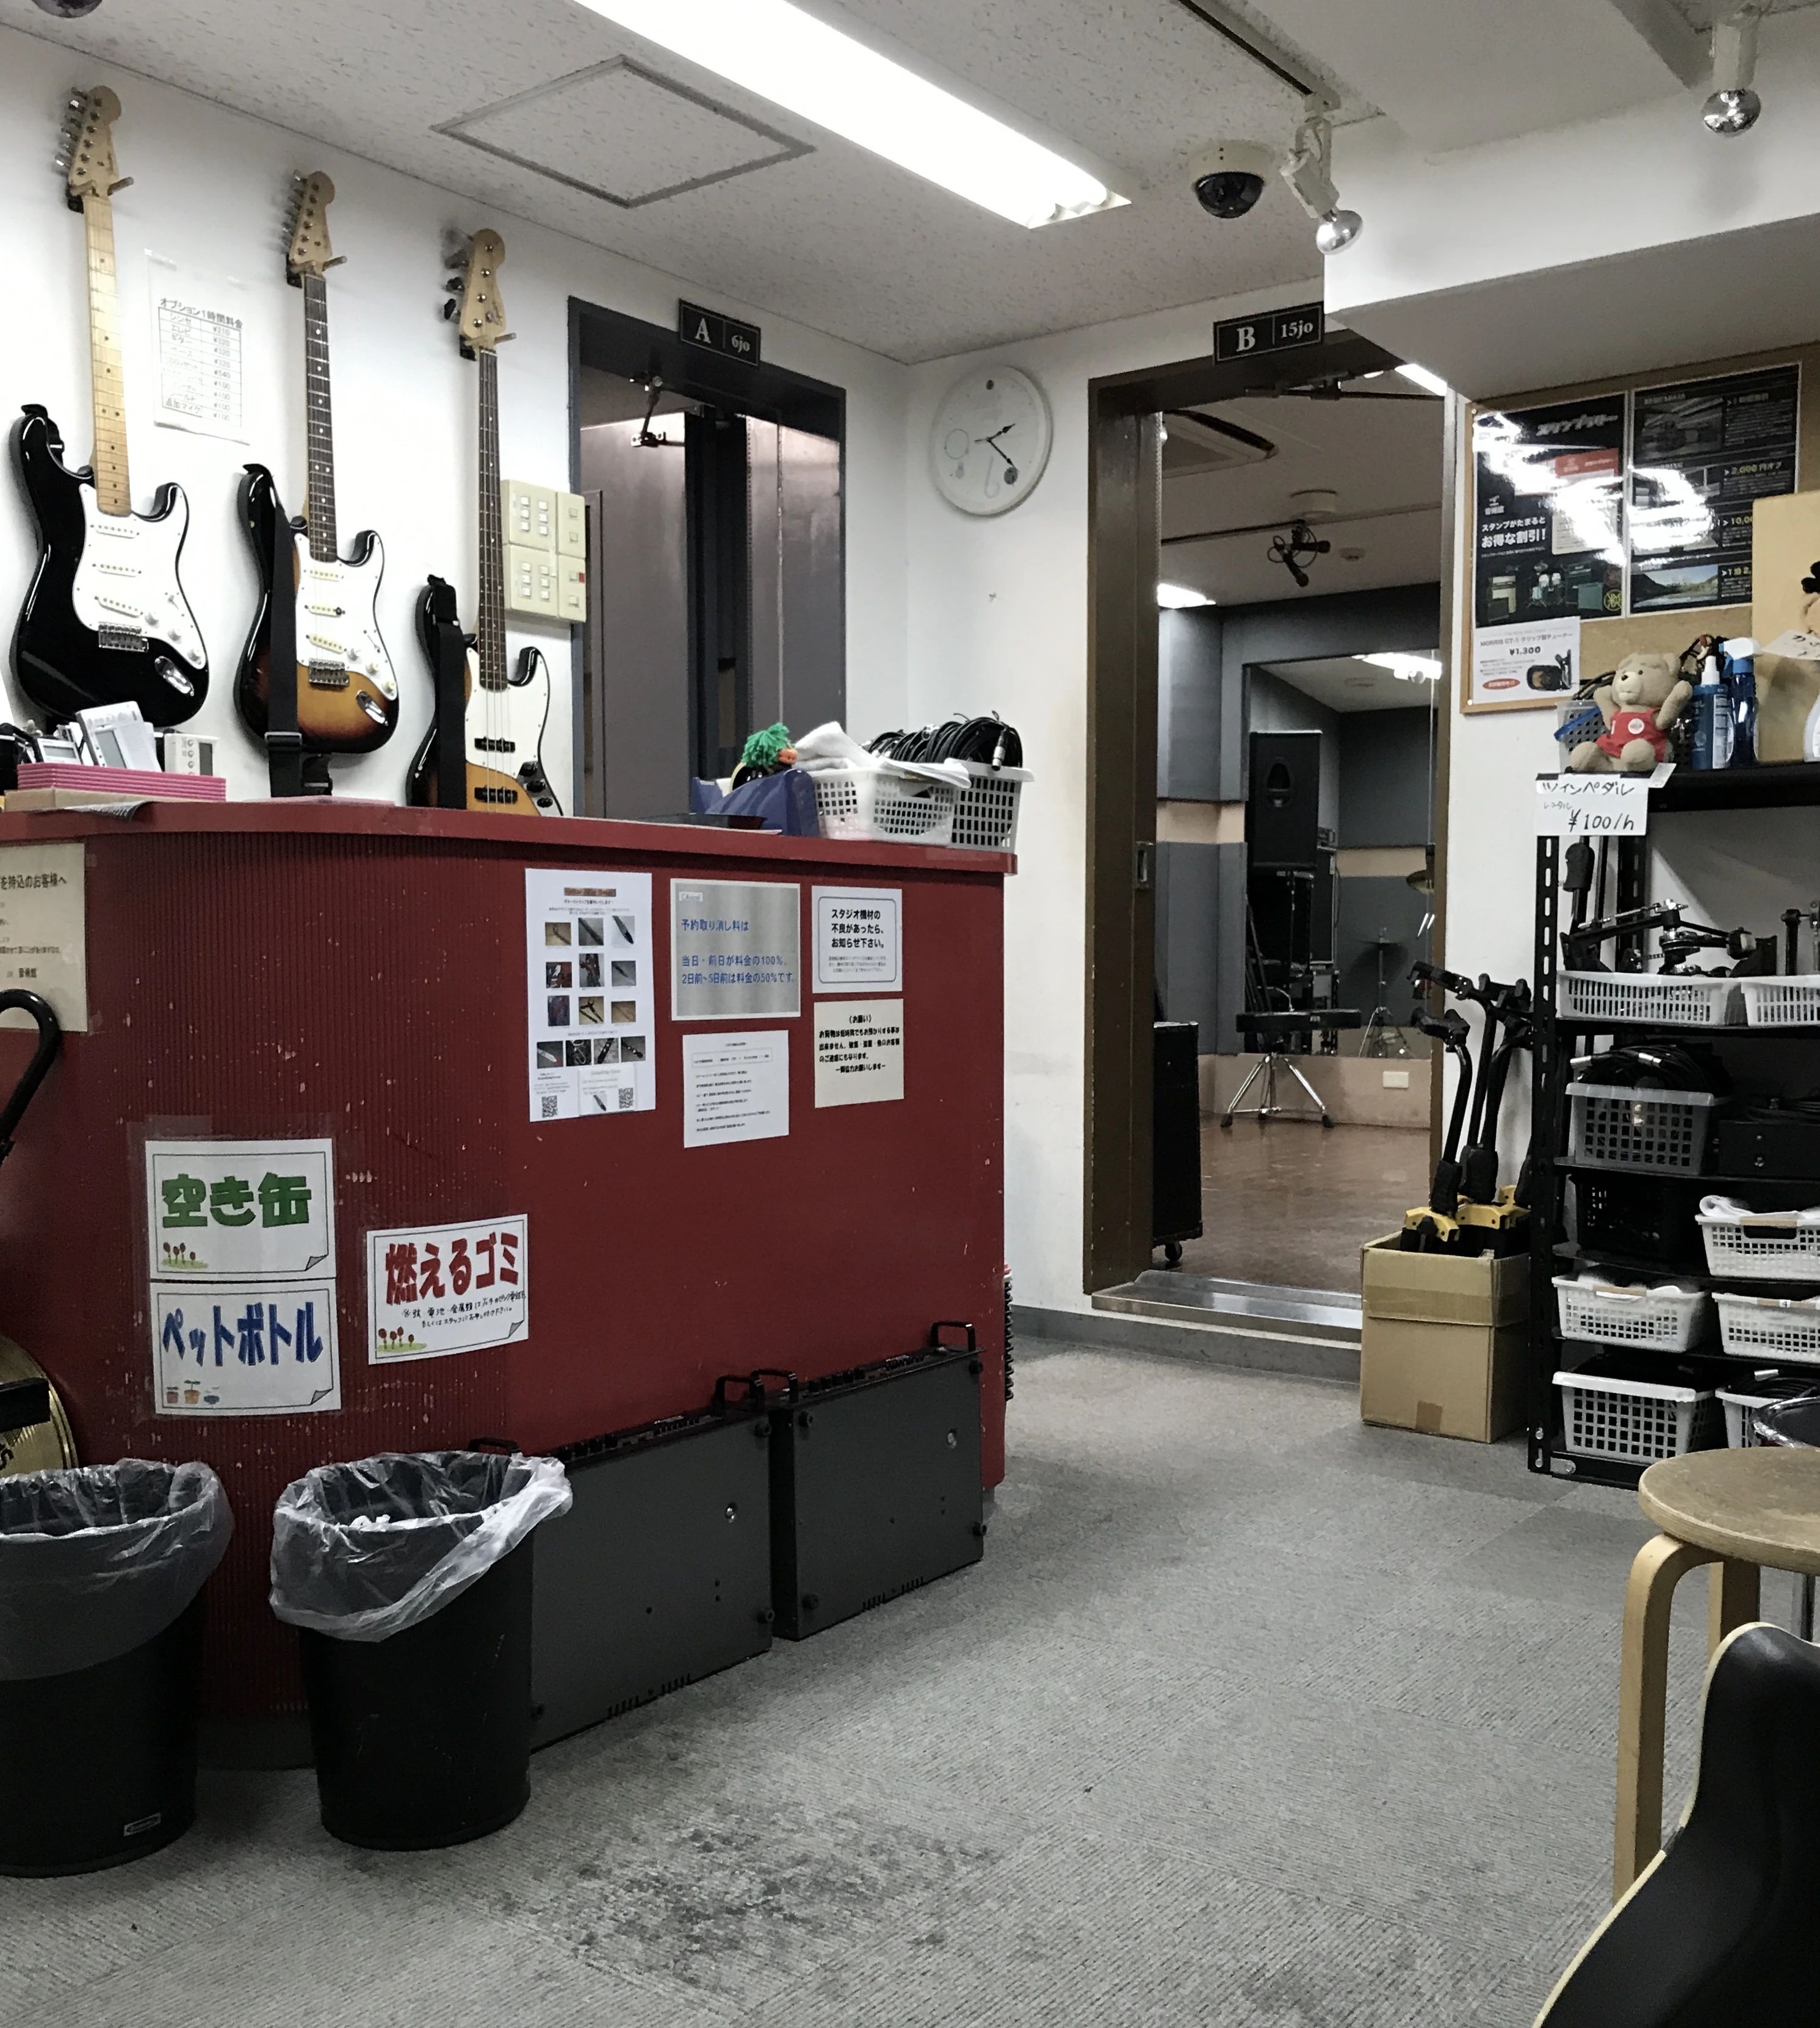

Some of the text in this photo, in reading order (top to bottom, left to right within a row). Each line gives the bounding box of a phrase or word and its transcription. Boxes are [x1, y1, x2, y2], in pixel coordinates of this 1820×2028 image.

[161, 298, 243, 330] オプション1時間料金
[695, 318, 751, 353] A 6jo
[1236, 320, 1314, 352] B 15jo
[1482, 516, 1545, 532] スタンプがたまると
[1542, 781, 1634, 796] ツインペダル
[0, 872, 67, 890] を持込のお客様へ
[831, 909, 881, 920] スタジオ機材の
[682, 919, 749, 931] 予約取り消し料は
[831, 923, 884, 934] 不良があったら、
[831, 938, 884, 948] お知らせ下さい。
[161, 1172, 312, 1228] 空き缶
[386, 1232, 519, 1305] 燃えるゴミ
[162, 1301, 323, 1367] ペットボトル
